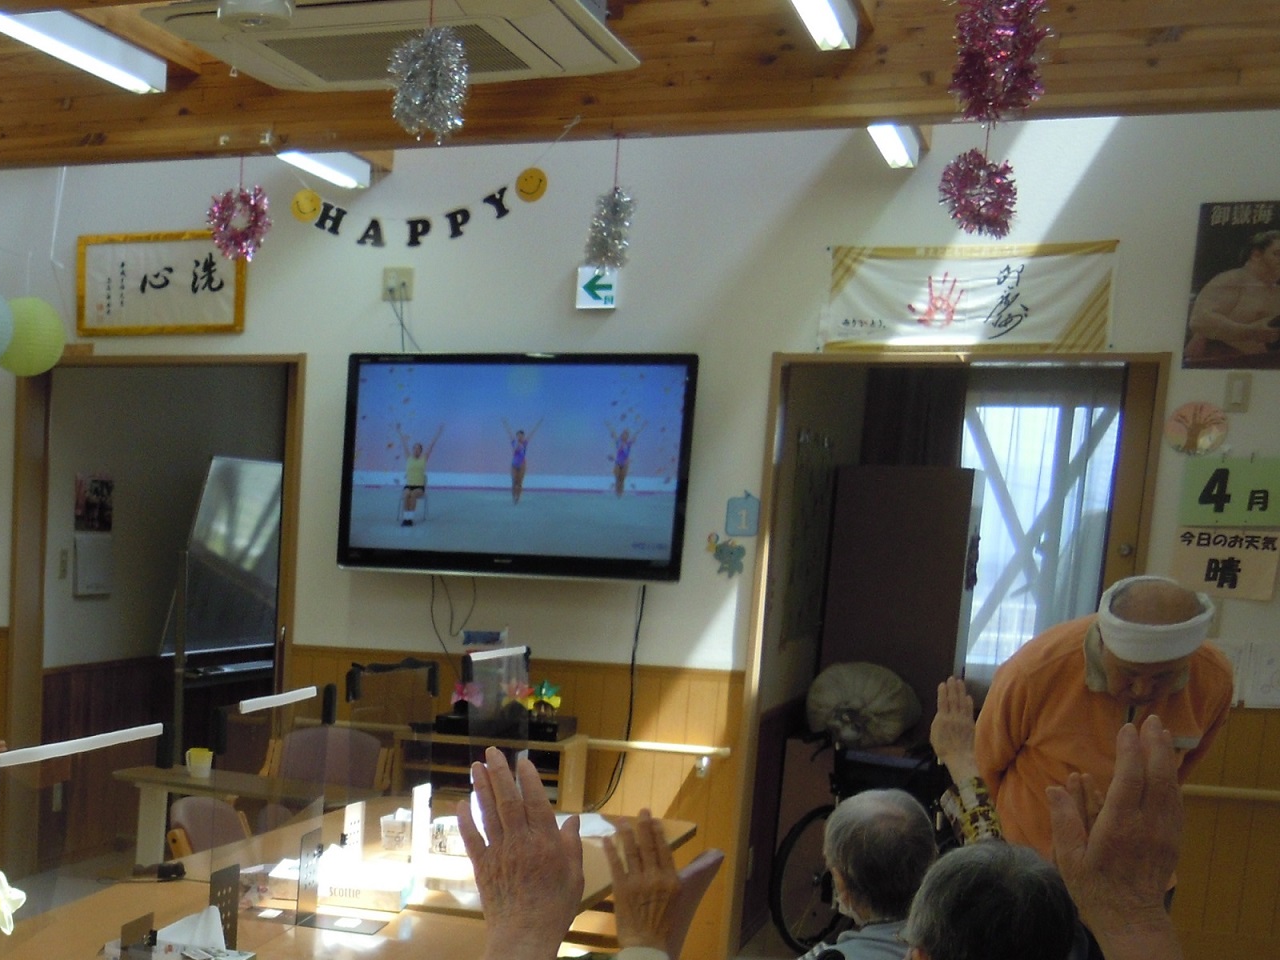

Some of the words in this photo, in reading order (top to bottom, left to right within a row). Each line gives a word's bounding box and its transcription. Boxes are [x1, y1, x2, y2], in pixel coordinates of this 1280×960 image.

[315, 186, 510, 247] HAPPY
[1180, 531, 1278, 552] 今日のお天気
[1204, 556, 1242, 590] 晴
